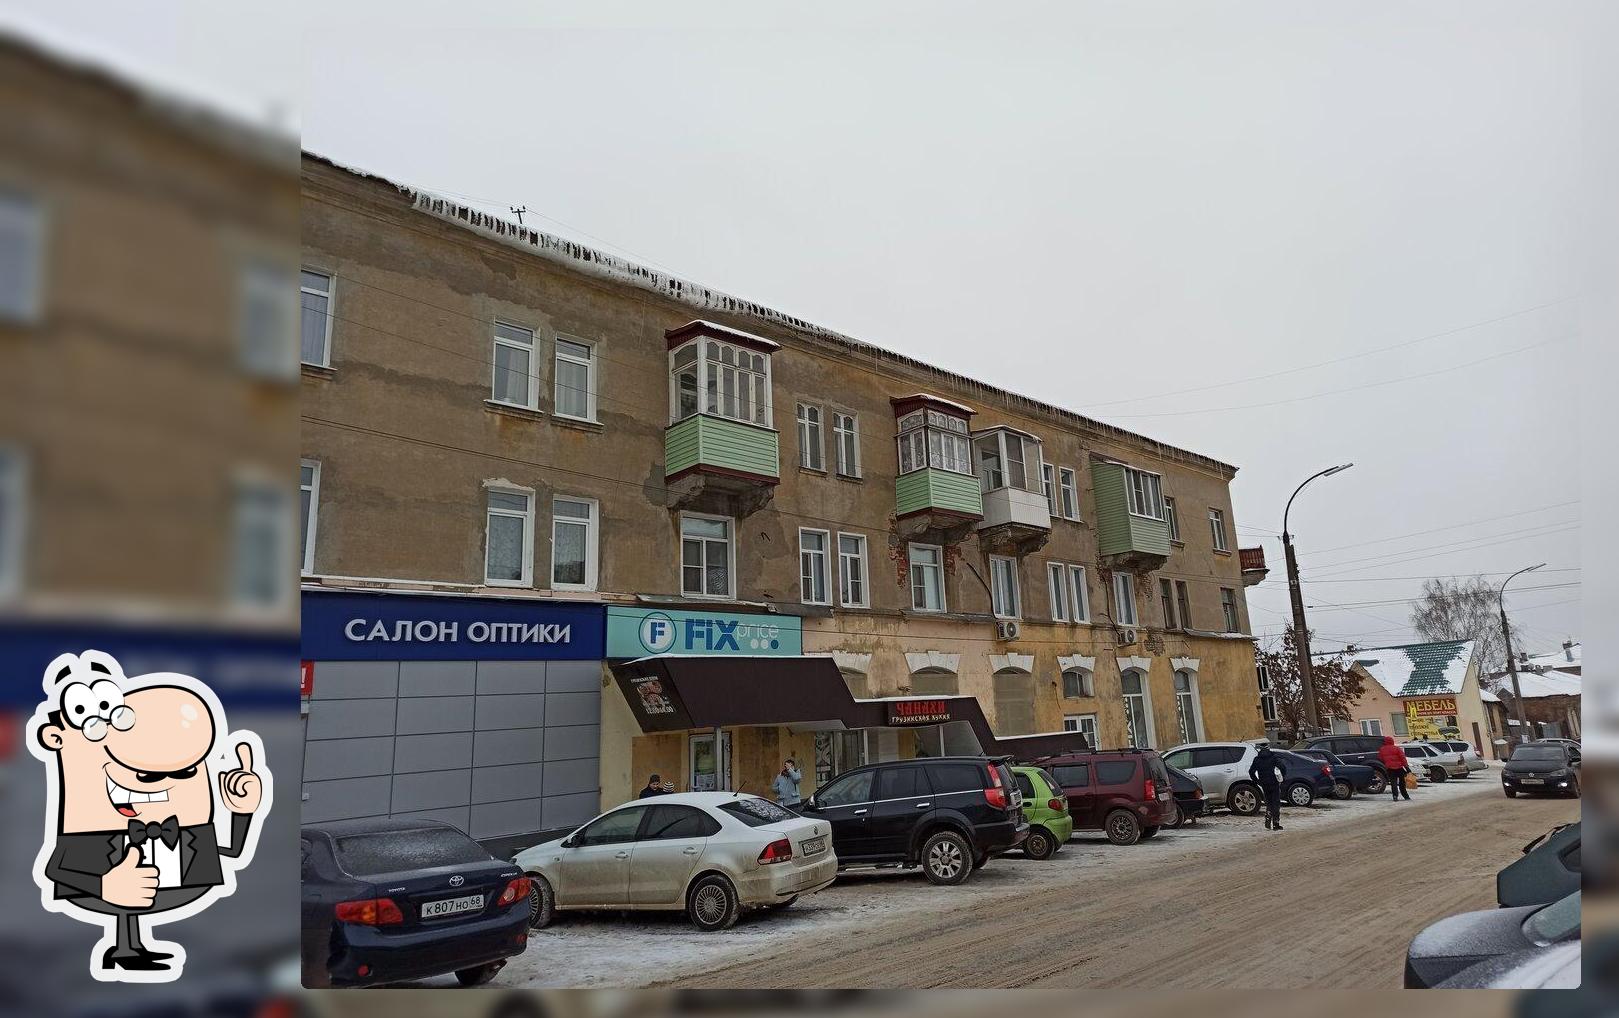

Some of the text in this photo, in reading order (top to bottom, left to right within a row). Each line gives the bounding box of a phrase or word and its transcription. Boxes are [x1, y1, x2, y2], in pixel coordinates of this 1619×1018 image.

[344, 618, 571, 644] САЛОН ОПТИКИ
[650, 621, 666, 644] F
[1406, 699, 1456, 712] МЕБЕЛЬ
